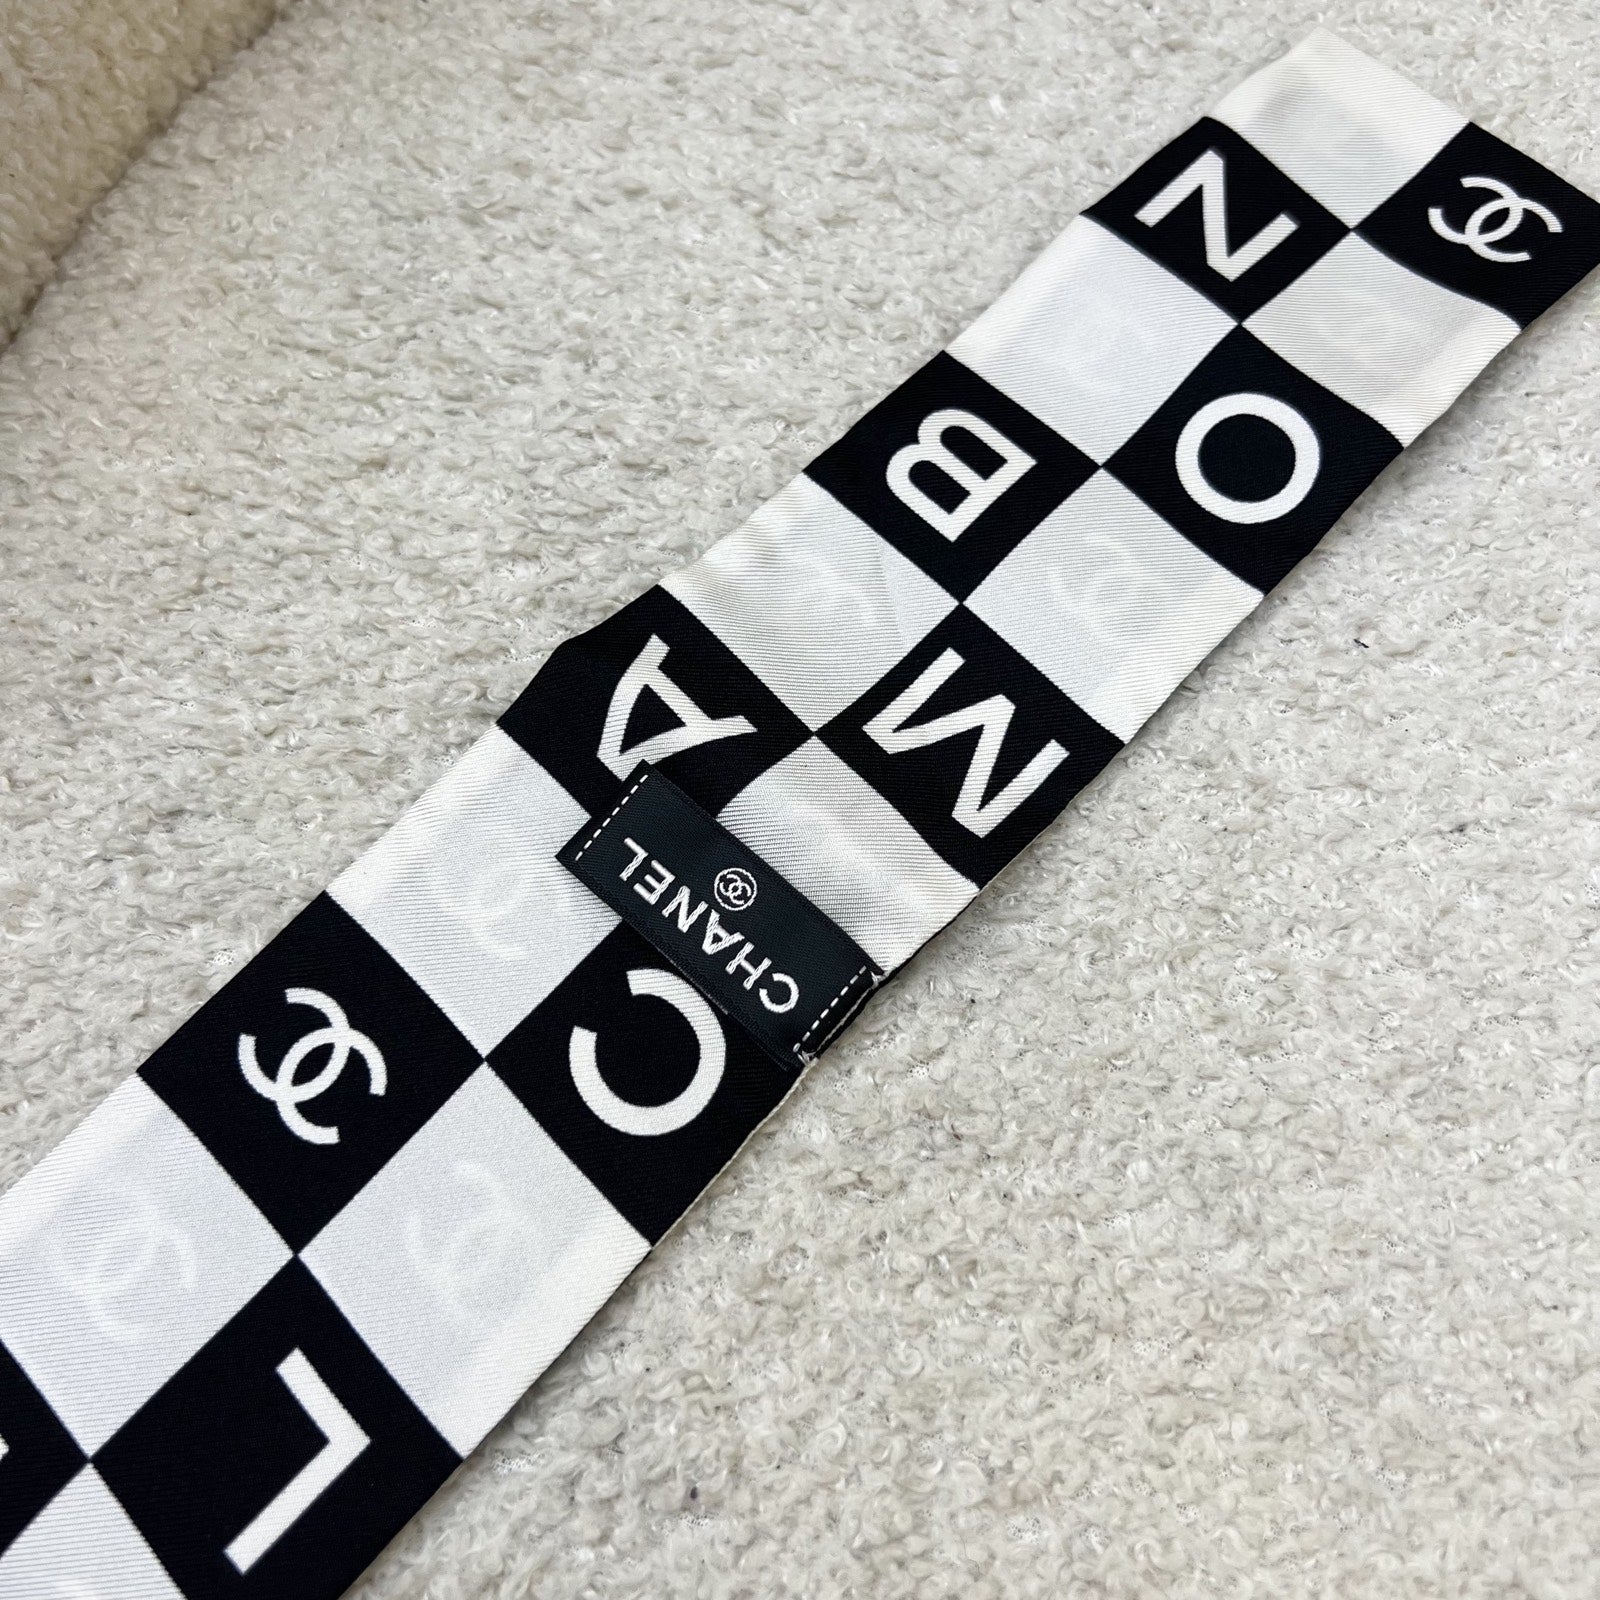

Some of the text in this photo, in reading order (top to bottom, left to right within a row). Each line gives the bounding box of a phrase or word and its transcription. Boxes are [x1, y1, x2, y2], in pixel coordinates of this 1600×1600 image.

[1135, 151, 1297, 281] N
[885, 408, 1037, 543] B
[1175, 392, 1321, 525] O
[597, 634, 757, 782] A
[862, 647, 1069, 838] M
[619, 837, 800, 1014] CHANEL
[568, 968, 727, 1136] C
[224, 1347, 371, 1574] L
